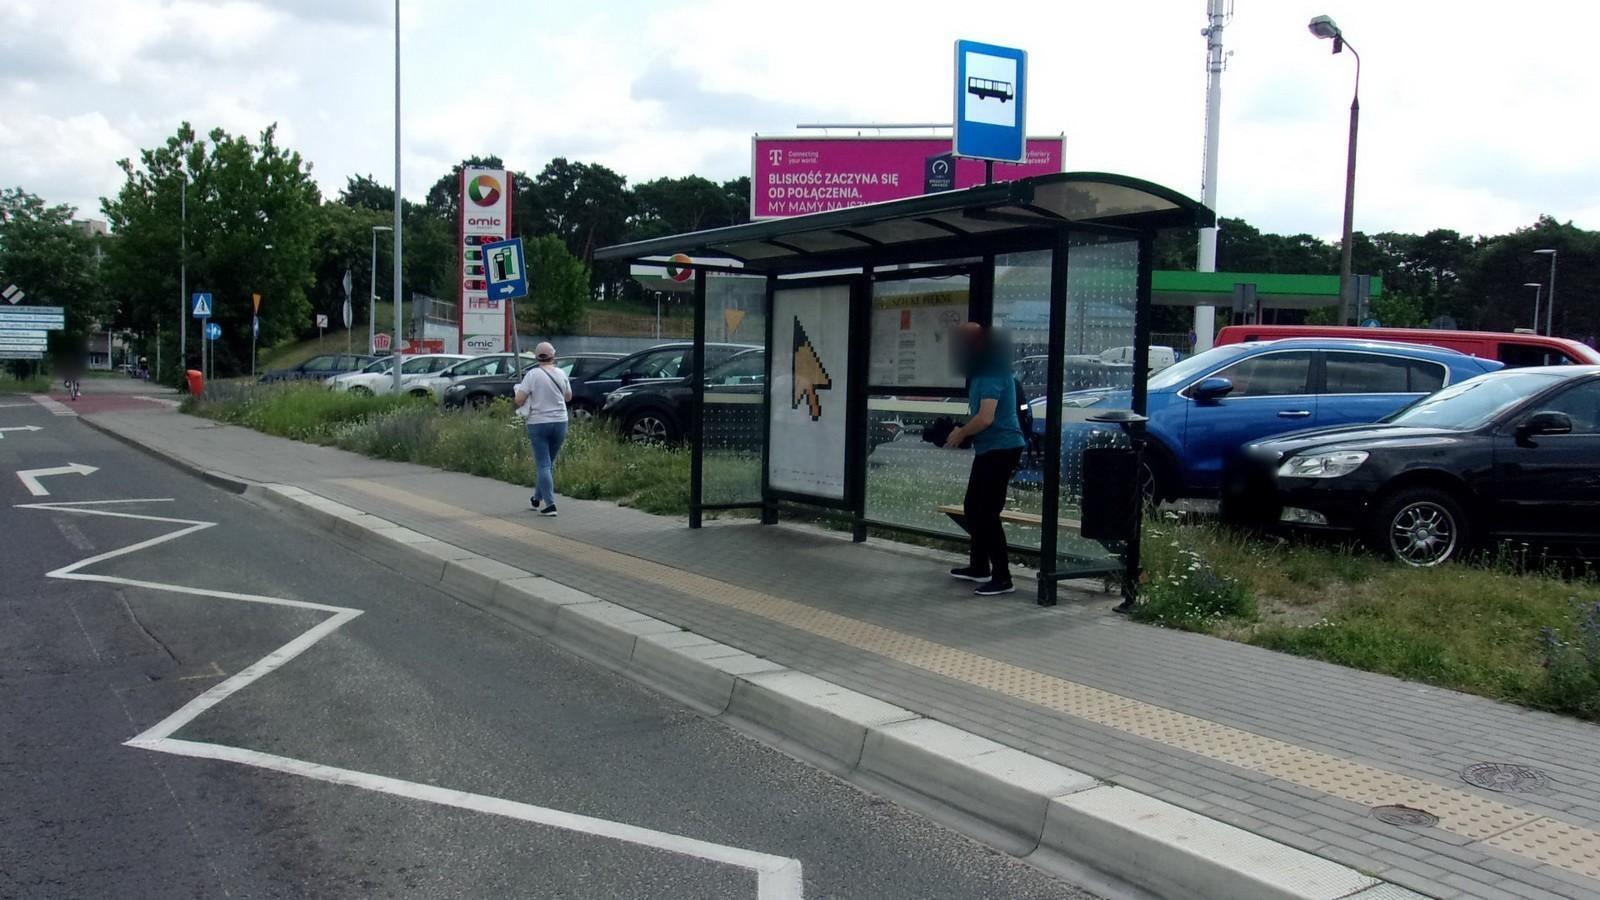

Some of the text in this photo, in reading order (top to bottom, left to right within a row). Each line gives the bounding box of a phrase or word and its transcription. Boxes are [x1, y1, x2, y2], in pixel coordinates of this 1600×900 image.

[769, 149, 783, 166] T
[769, 170, 899, 187] BLISKOŚĆ ZACZYNA SIĘ
[769, 187, 863, 201] OD POŁĄCZENIA.
[768, 202, 786, 212] MY
[788, 201, 826, 212] MAMY
[468, 216, 501, 226] amic
[467, 339, 494, 348] amic
